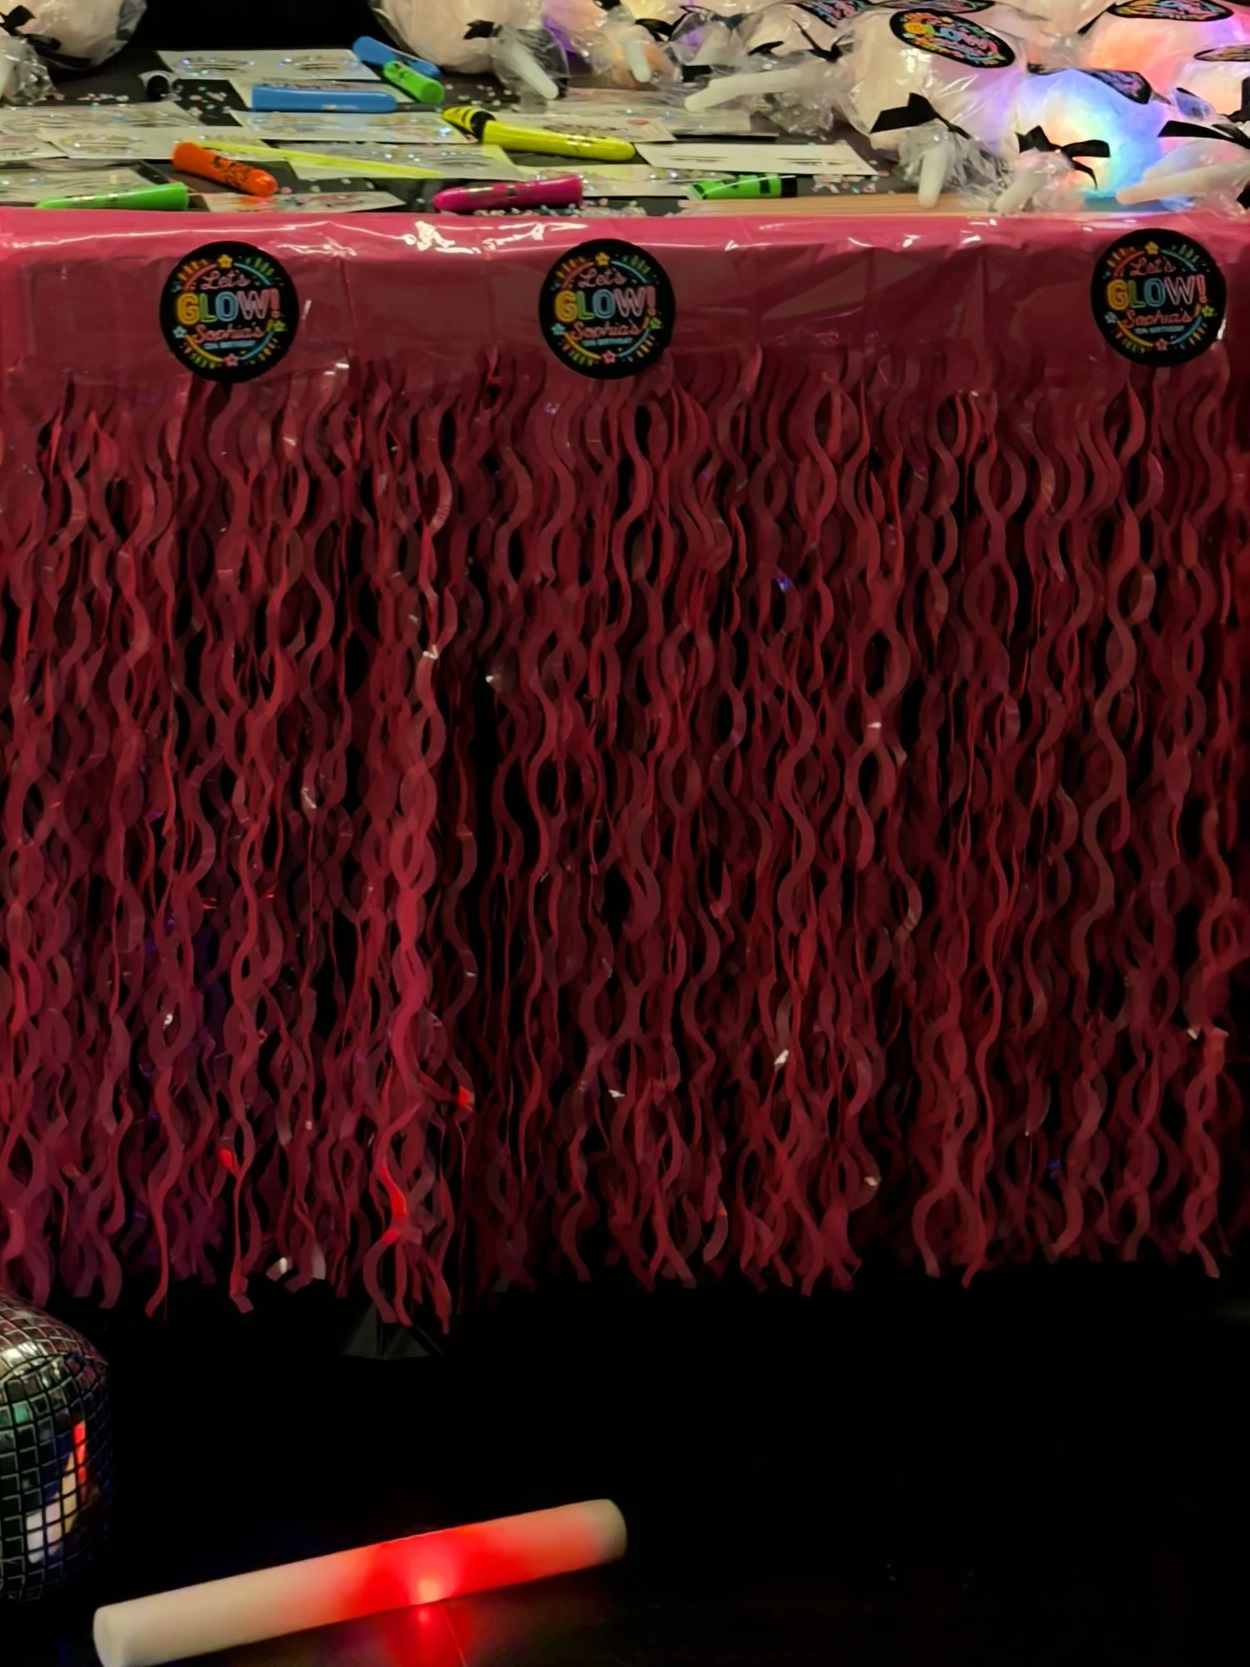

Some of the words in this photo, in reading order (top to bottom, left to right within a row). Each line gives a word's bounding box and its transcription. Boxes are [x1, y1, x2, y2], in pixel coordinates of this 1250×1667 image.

[177, 288, 280, 324] GLOW!
[555, 285, 656, 322] GLOW!
[1107, 274, 1207, 310] GLOW!
